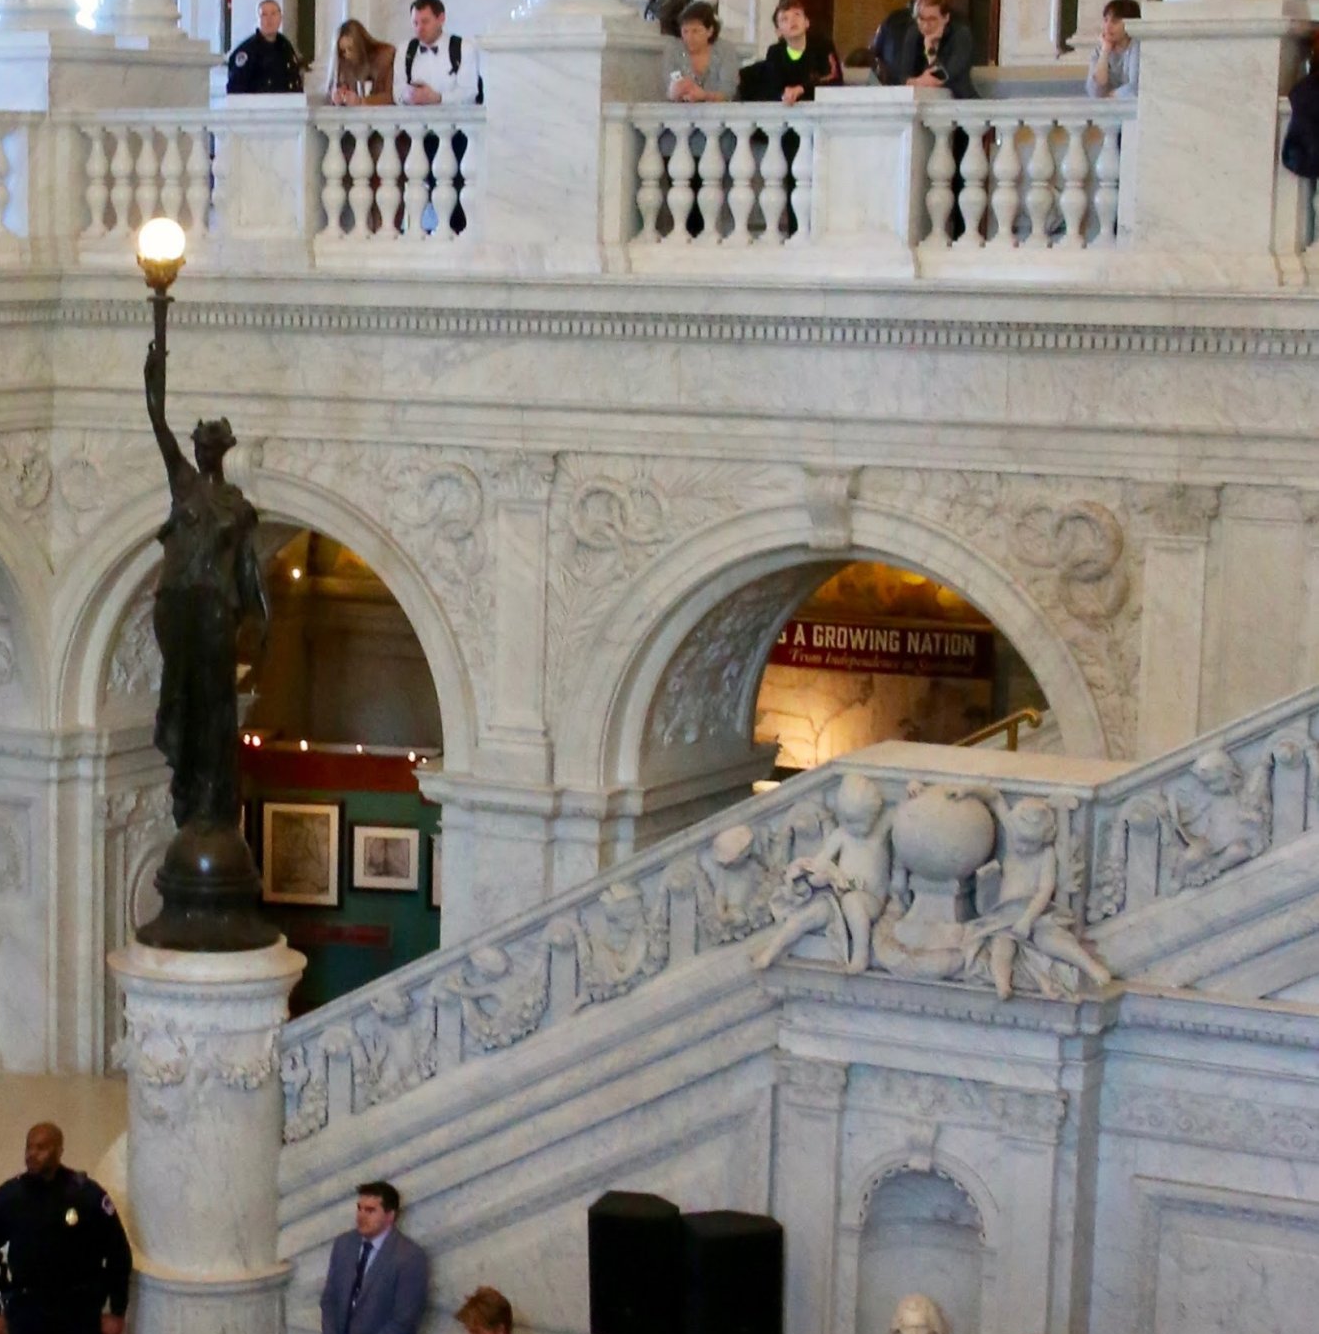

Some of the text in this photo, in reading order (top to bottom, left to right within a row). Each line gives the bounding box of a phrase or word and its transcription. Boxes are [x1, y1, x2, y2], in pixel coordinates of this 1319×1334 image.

[793, 623, 806, 646] A
[812, 624, 900, 653] GROWING
[907, 631, 977, 657] NATION
[789, 646, 823, 665] From
